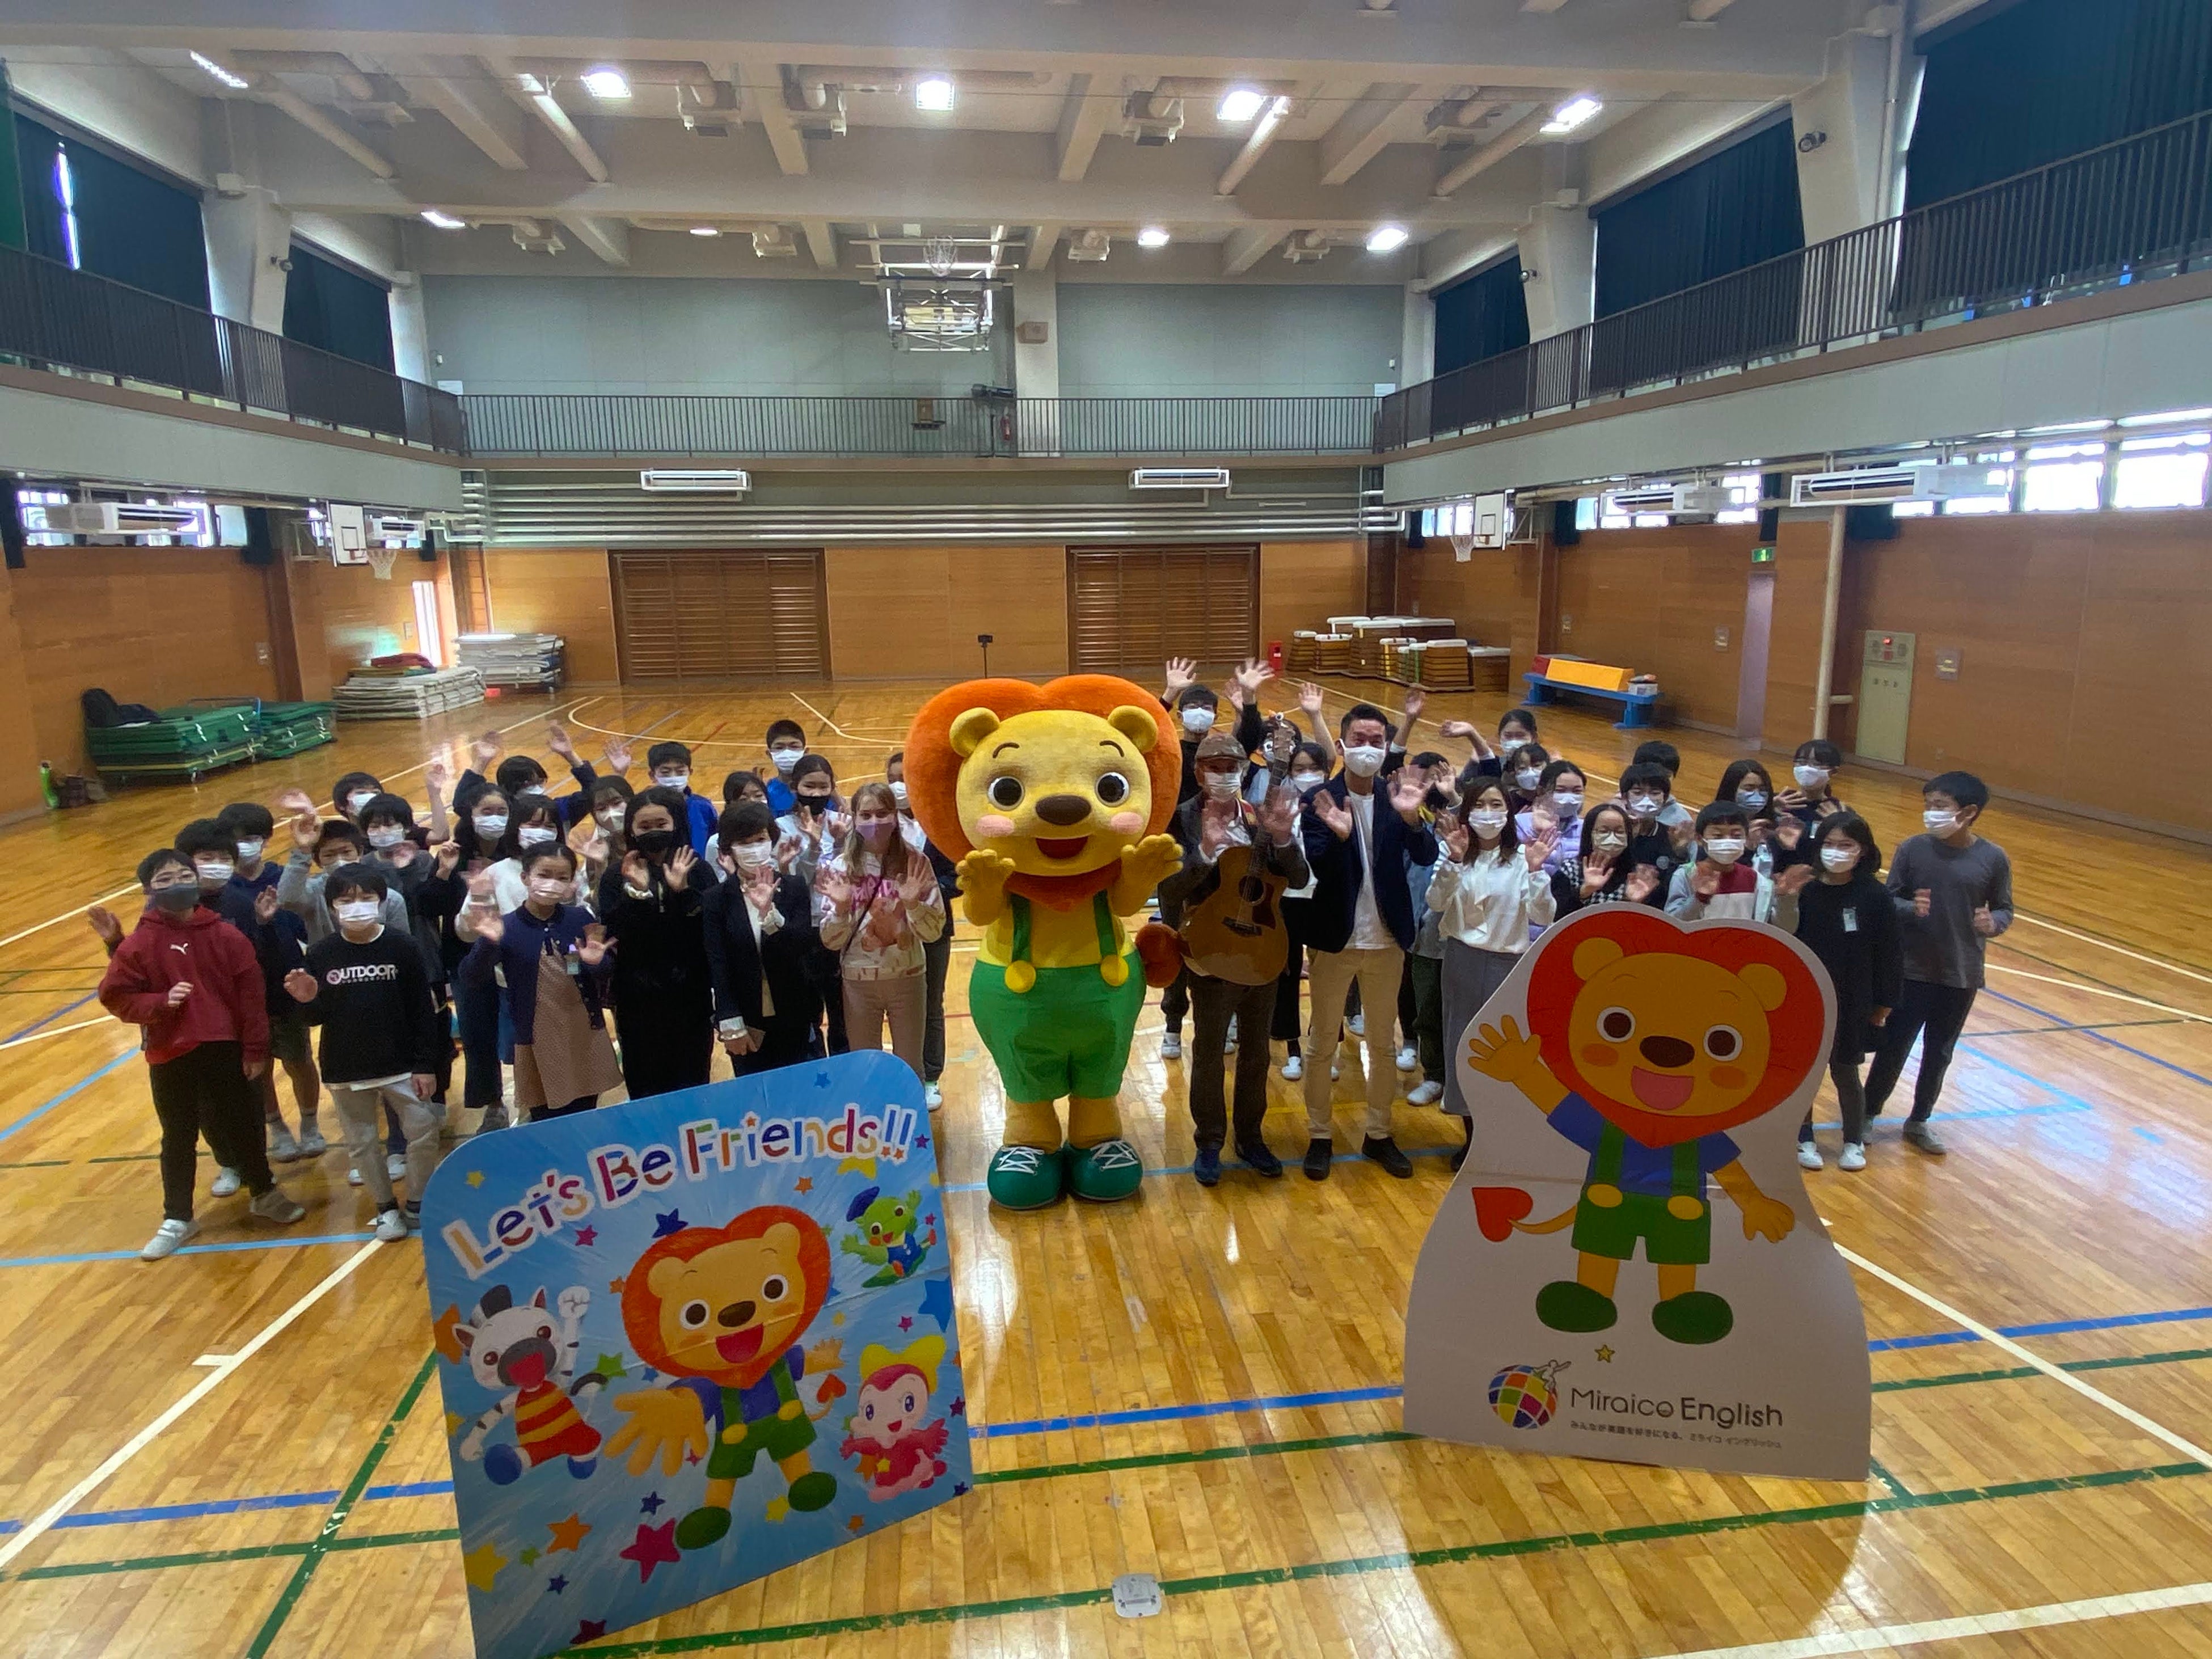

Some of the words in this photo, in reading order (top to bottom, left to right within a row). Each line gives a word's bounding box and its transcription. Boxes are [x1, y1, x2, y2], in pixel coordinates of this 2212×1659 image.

[326, 965, 396, 985] OUTDOOR
[448, 1172, 591, 1274] Let's
[594, 1147, 673, 1204] Be
[683, 1107, 914, 1176] Friends!!
[1571, 1387, 1674, 1418] Miraico
[1681, 1396, 1783, 1429] English
